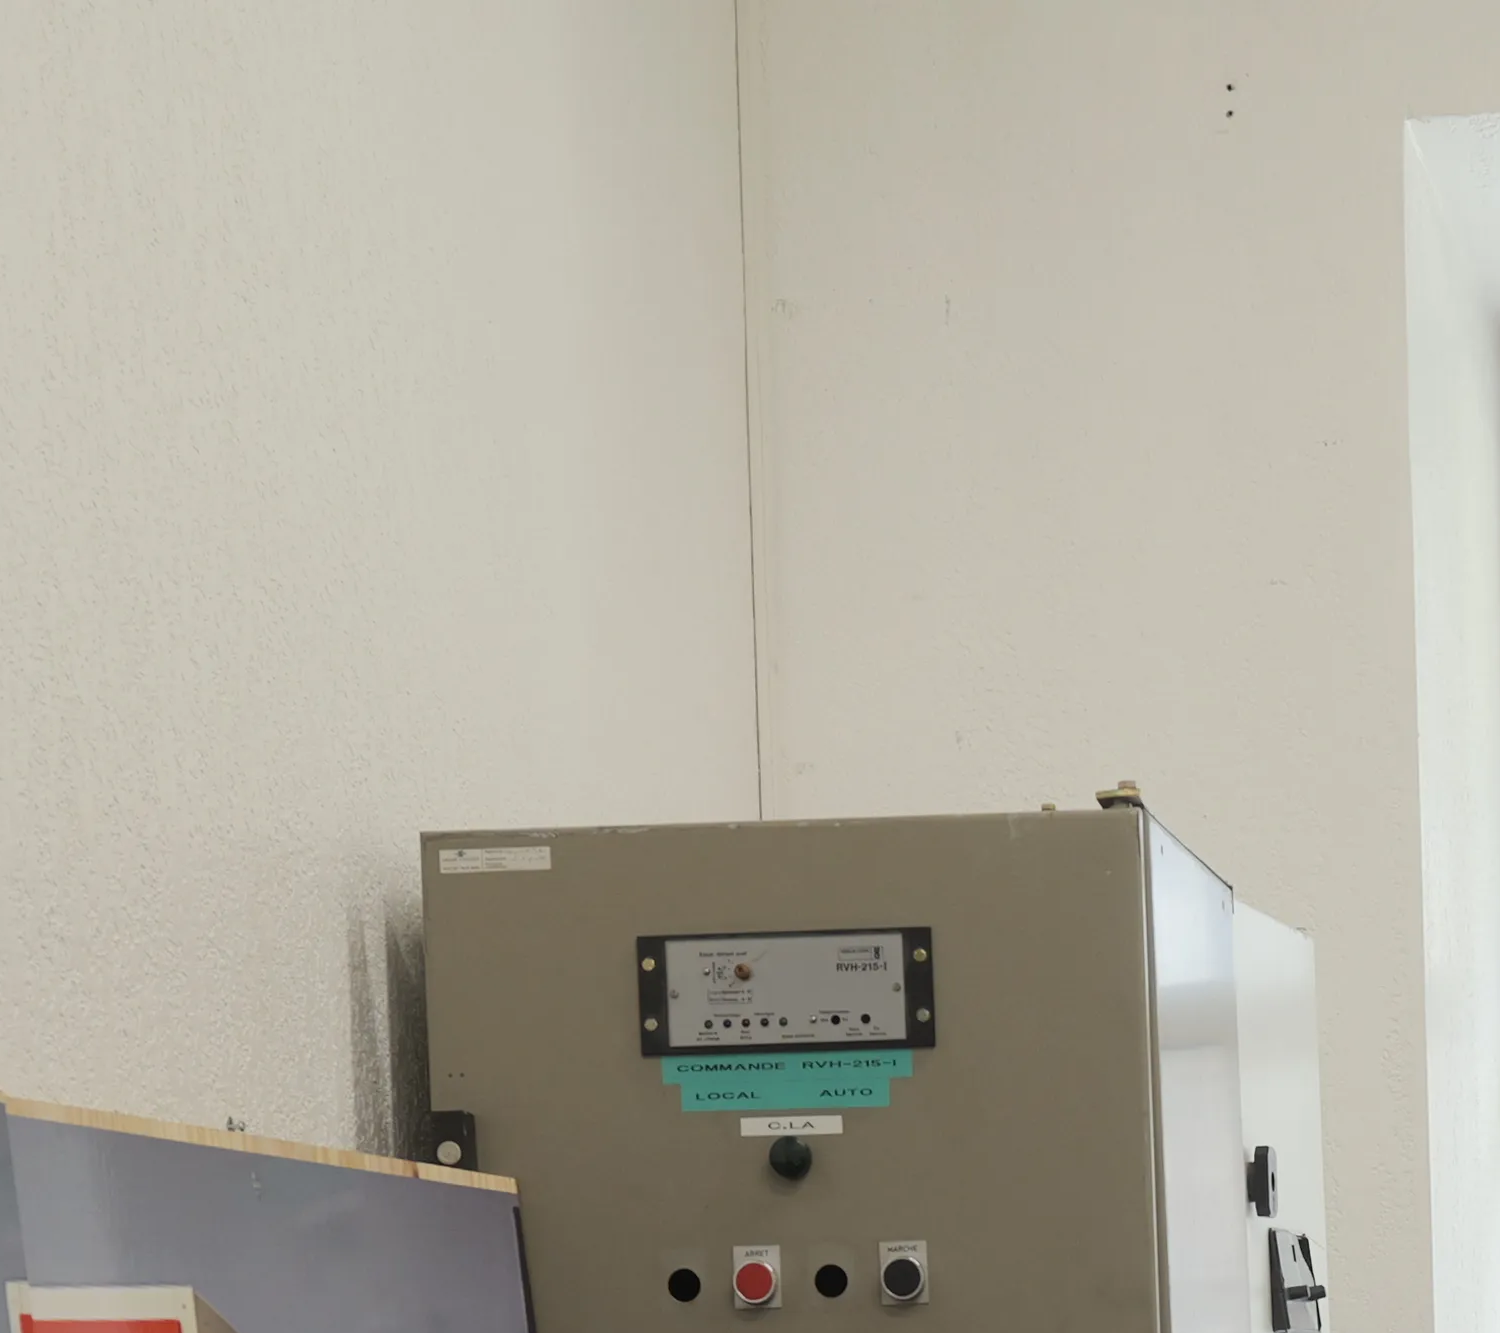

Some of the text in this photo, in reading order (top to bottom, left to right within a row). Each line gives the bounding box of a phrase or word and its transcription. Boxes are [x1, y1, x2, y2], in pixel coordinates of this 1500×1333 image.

[836, 962, 888, 974] RVH-215-I
[676, 1059, 897, 1073] COMMANDE RVH-215-I
[696, 1091, 761, 1101] LOCAL
[820, 1087, 873, 1098] AUTO
[887, 1245, 918, 1253] MARCHE
